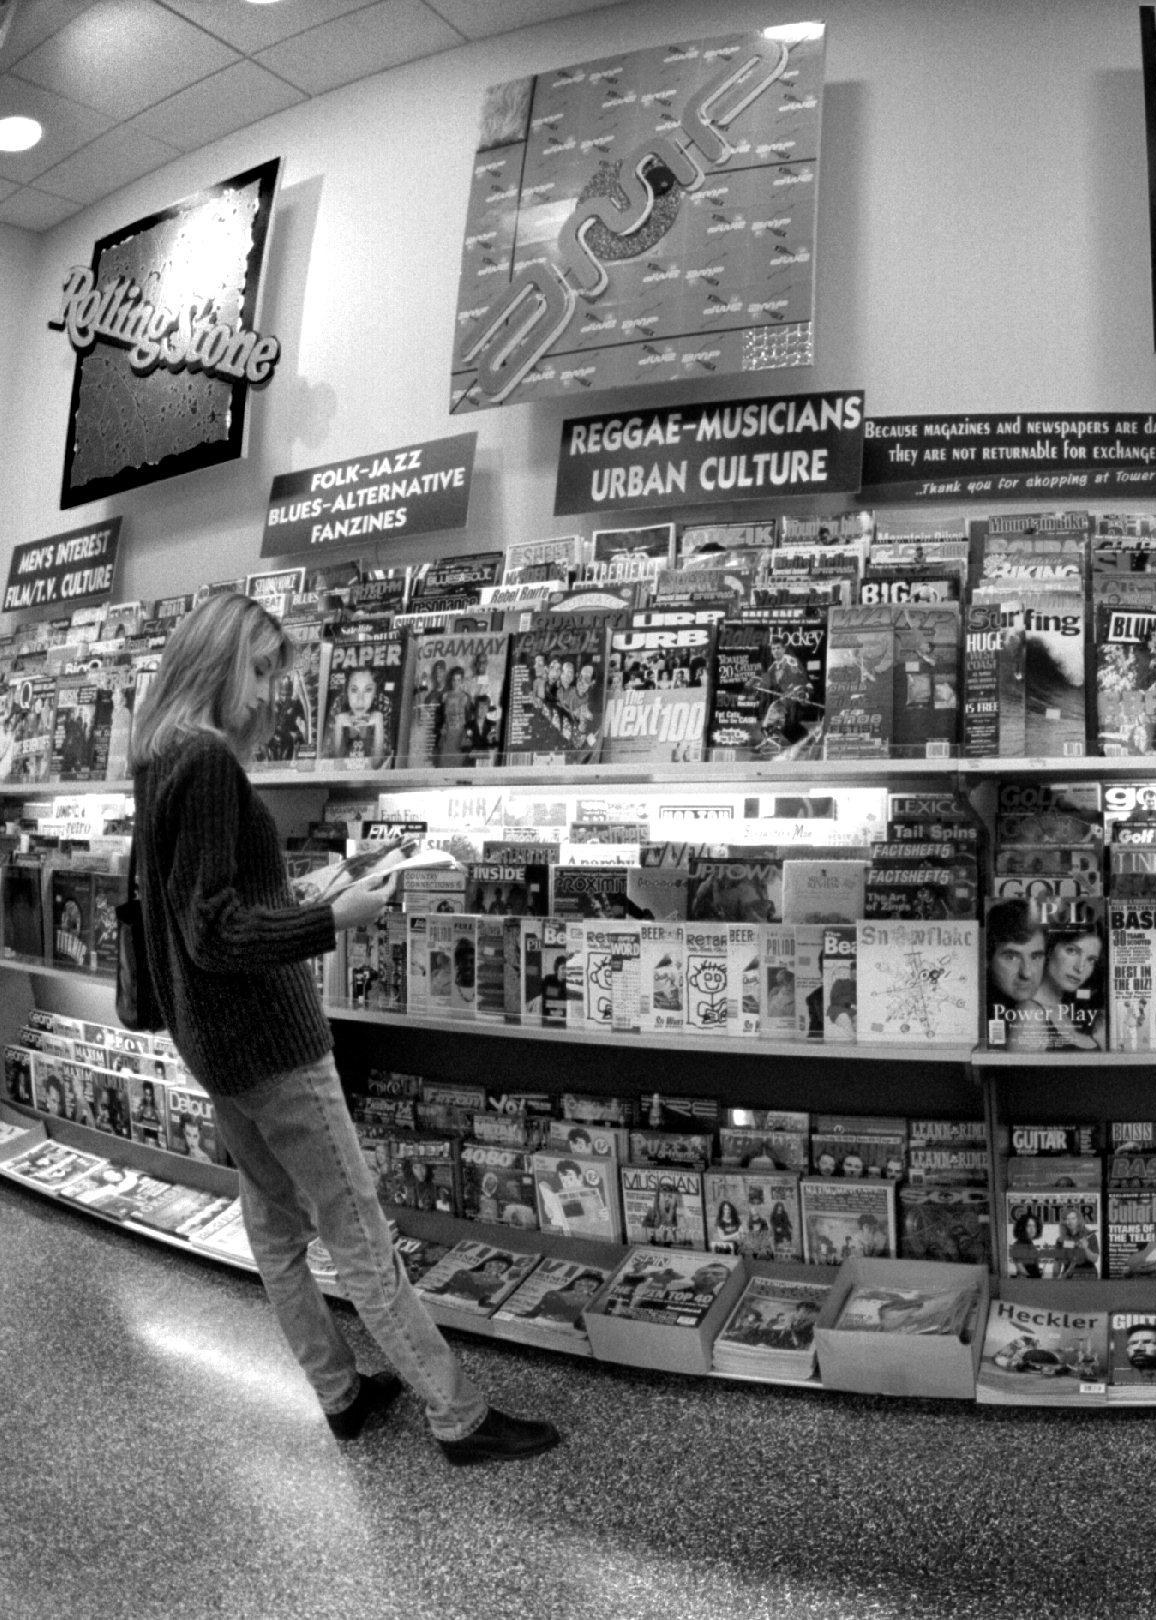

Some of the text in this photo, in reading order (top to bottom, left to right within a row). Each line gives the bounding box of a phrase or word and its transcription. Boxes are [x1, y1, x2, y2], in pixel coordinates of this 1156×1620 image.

[62, 266, 281, 384] Rolling Stone
[569, 396, 862, 456] REGGAE-MUSICIANS
[311, 449, 423, 491] FOLK-JAZZ
[591, 448, 828, 501] URBAN CULTURE
[967, 480, 992, 494] you
[998, 476, 1020, 490] for
[1026, 473, 1088, 488] shopping
[1095, 471, 1110, 484] at
[269, 467, 466, 526] BLUES-ALTERNATIVE
[311, 507, 408, 543] FANZINES
[19, 531, 111, 574] MEN'S INTEREST
[5, 563, 113, 609] FILM/T.V. CULTURE
[861, 582, 912, 605] BIG
[967, 607, 1082, 638] Surfing
[419, 639, 506, 661] GRAMMY
[611, 629, 709, 650] URB
[769, 625, 825, 653] Hockey
[966, 632, 1004, 653] HUGE
[332, 645, 401, 668] PAPER
[623, 690, 646, 704] THE
[604, 696, 706, 743] Next 100
[893, 823, 978, 841] Tail Spins
[473, 867, 526, 882] INSIDE
[866, 902, 877, 911] of
[867, 892, 906, 902] The Art
[641, 927, 665, 941] BEER
[729, 929, 753, 943] BEER
[861, 926, 973, 948] Snowflake
[1115, 965, 1151, 979] BEST IN
[1115, 978, 1130, 991] THE
[992, 1004, 1098, 1026] Power Play
[170, 1091, 214, 1119] Detour
[911, 1122, 951, 1139] LEANN
[1012, 1130, 1067, 1151] GUITAR
[462, 1149, 512, 1166] 4080
[911, 1151, 951, 1168] LEANN
[622, 1167, 700, 1196] MUSICIAN
[1109, 1199, 1151, 1224] Guitar
[1109, 1224, 1155, 1234] TITANS OF
[1109, 1234, 1127, 1243] THE
[668, 1291, 714, 1303] TOP 40
[998, 1303, 1098, 1329] Heckler
